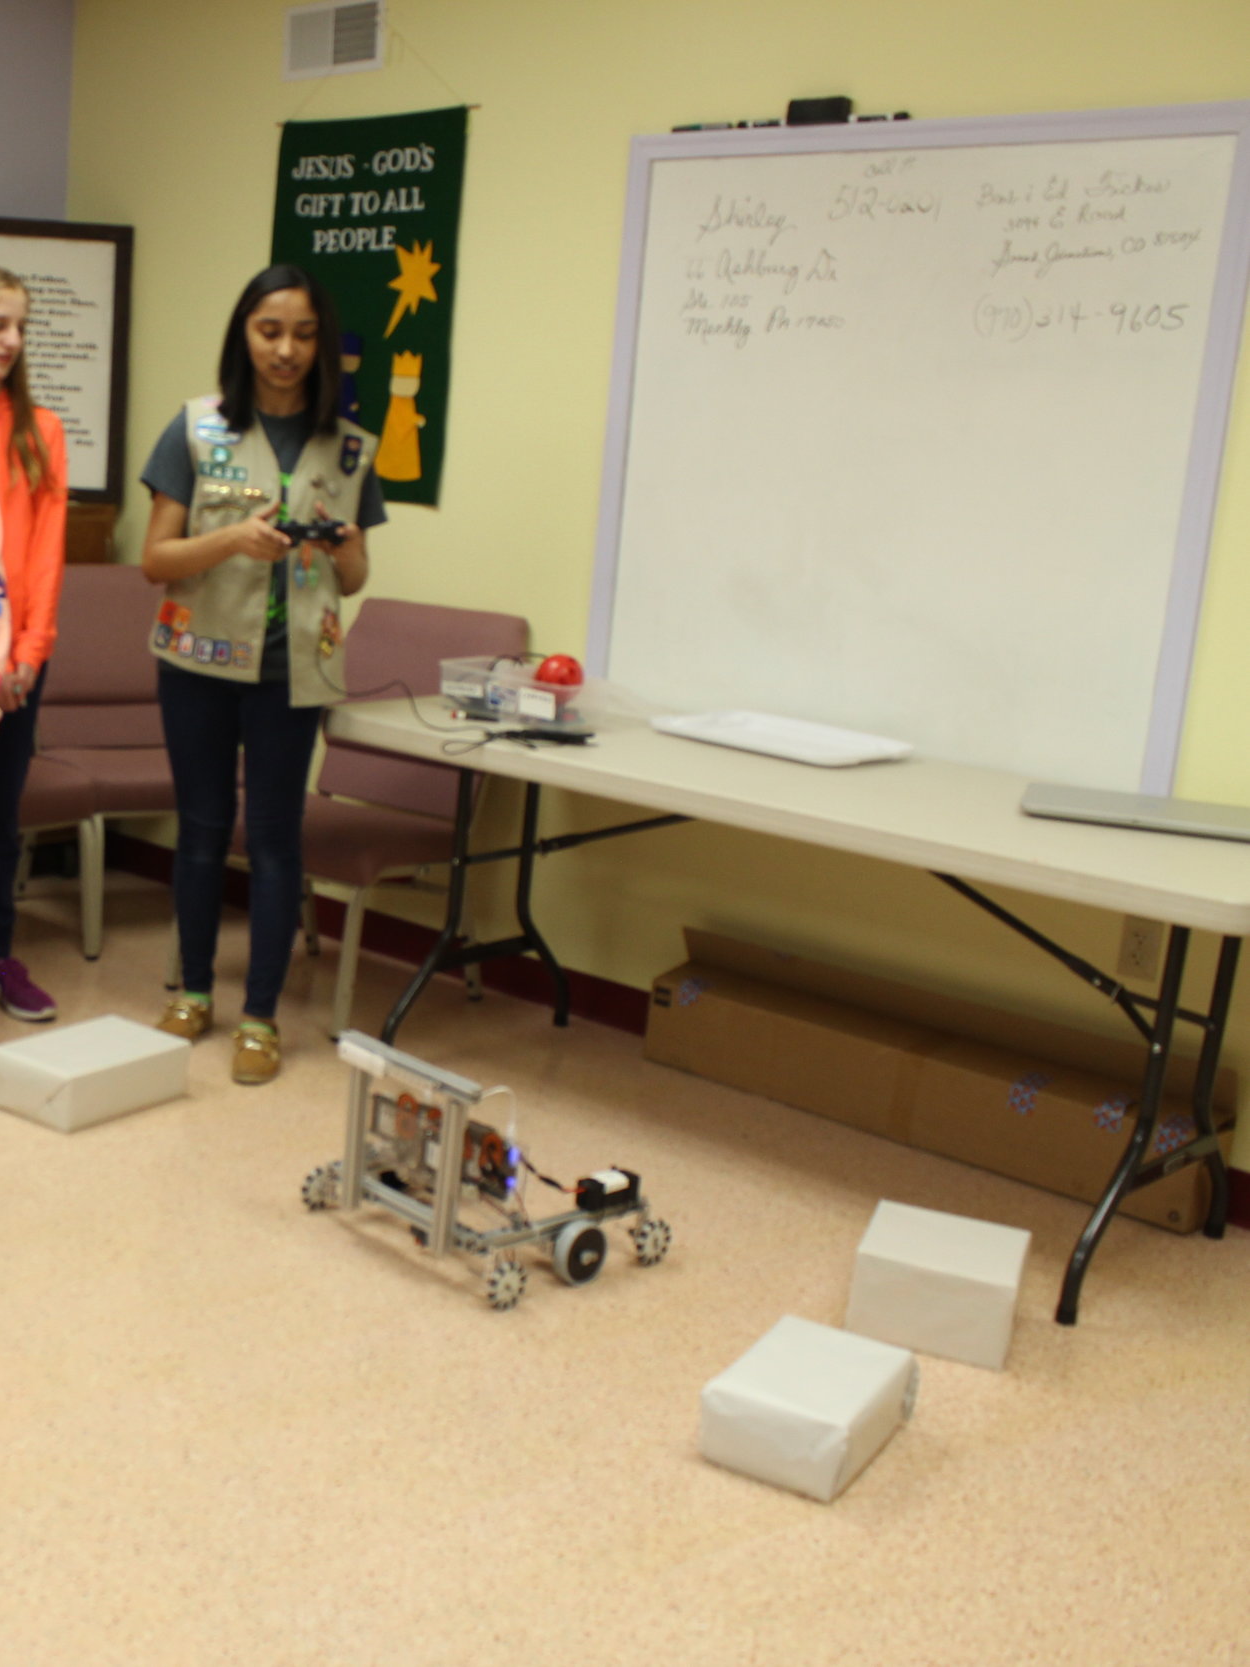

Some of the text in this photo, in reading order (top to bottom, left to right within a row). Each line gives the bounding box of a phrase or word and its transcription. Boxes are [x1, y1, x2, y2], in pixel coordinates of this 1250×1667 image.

[291, 154, 355, 180] JESUS
[295, 187, 425, 217] GIFT TO ALL
[312, 226, 397, 253] PEOPLE
